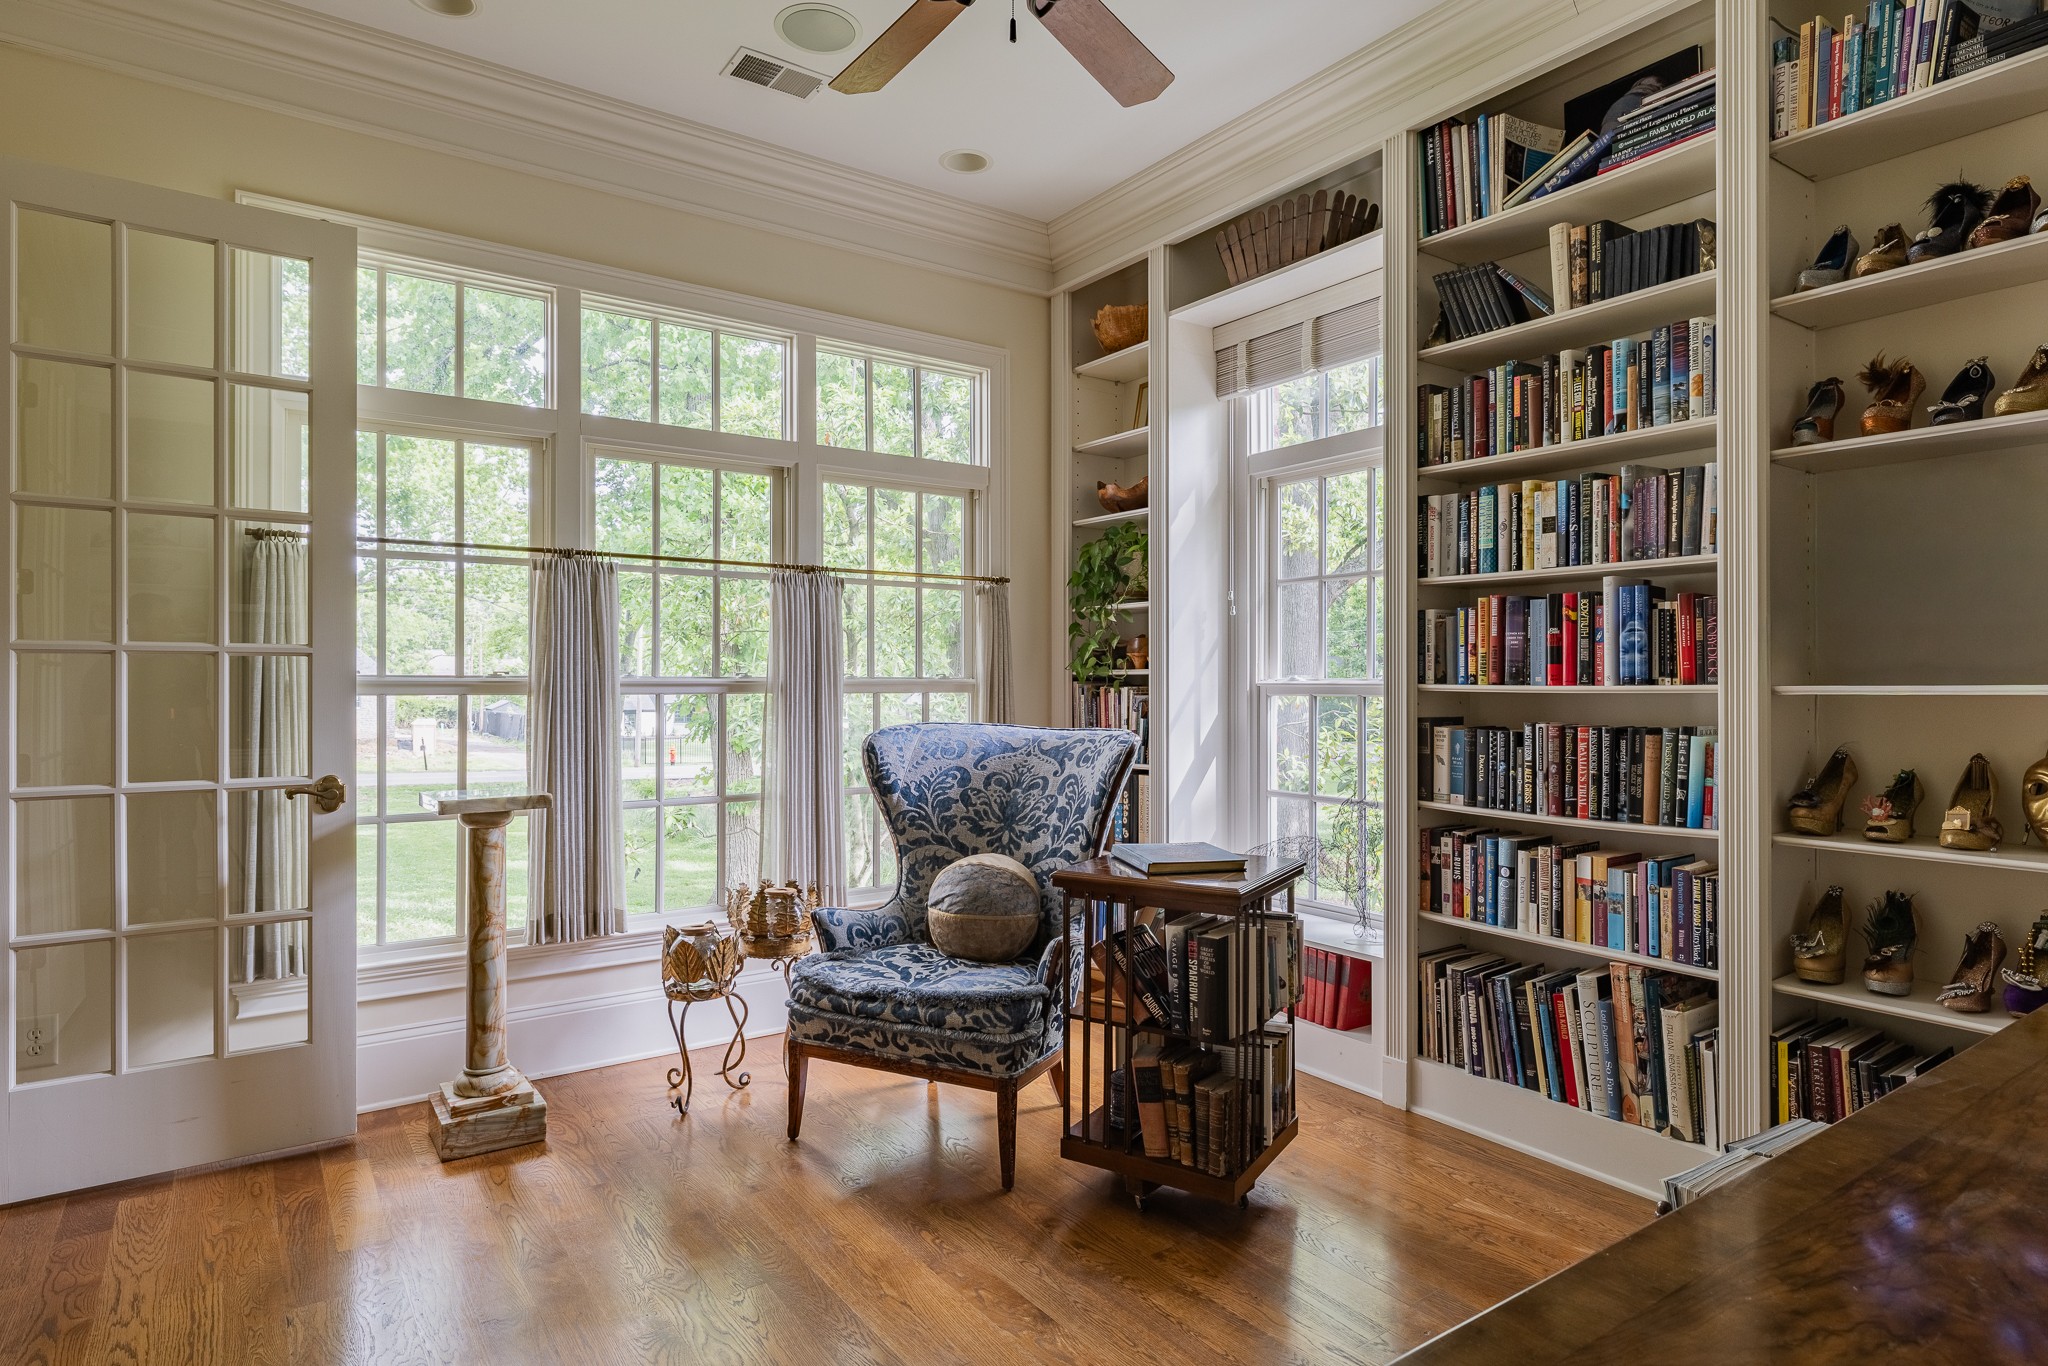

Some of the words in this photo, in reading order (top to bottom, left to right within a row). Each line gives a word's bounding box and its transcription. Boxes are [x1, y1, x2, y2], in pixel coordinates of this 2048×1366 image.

[1820, 60, 1828, 81] PARIS
[1776, 66, 1785, 108] FRANCE
[1518, 119, 1524, 128] TO
[1627, 127, 1640, 136] Atlas
[1648, 111, 1678, 128] Legendary
[1649, 124, 1669, 137] FAMILY
[1670, 114, 1695, 128] WORLD
[1696, 104, 1716, 118] ATLAS
[1607, 148, 1640, 165] EVEREST
[1611, 148, 1633, 158] MAINE
[1691, 323, 1700, 346] PATRICIA
[1691, 347, 1700, 371] CORNWELL
[1704, 351, 1712, 382] CATHERINE
[1573, 382, 1582, 392] LEE
[1573, 393, 1582, 406] CHILD
[1581, 618, 1589, 636] TRUTH
[1707, 616, 1717, 676] MOBY-DICK
[1540, 854, 1550, 891] SILMARILLION
[1500, 879, 1510, 918] Quicksilver
[1541, 906, 1550, 925] Tolkien
[1188, 940, 1198, 959] RED
[1189, 960, 1199, 1002] SPARROW
[1142, 993, 1164, 1019] CAUGHT
[1467, 990, 1478, 1024] VIENNA
[1559, 1019, 1568, 1040] KAHLO
[1575, 1010, 1583, 1041] LEONARDO
[1666, 1024, 1674, 1050] ITALIAN
[1582, 1000, 1602, 1092] SCULPTURE
[1602, 1025, 1610, 1054] Putnam
[1605, 1060, 1613, 1075] So
[1668, 1053, 1677, 1100] RENAISSANCE
[1812, 1051, 1821, 1106] AMERICAS
[1606, 1077, 1615, 1097] Far
